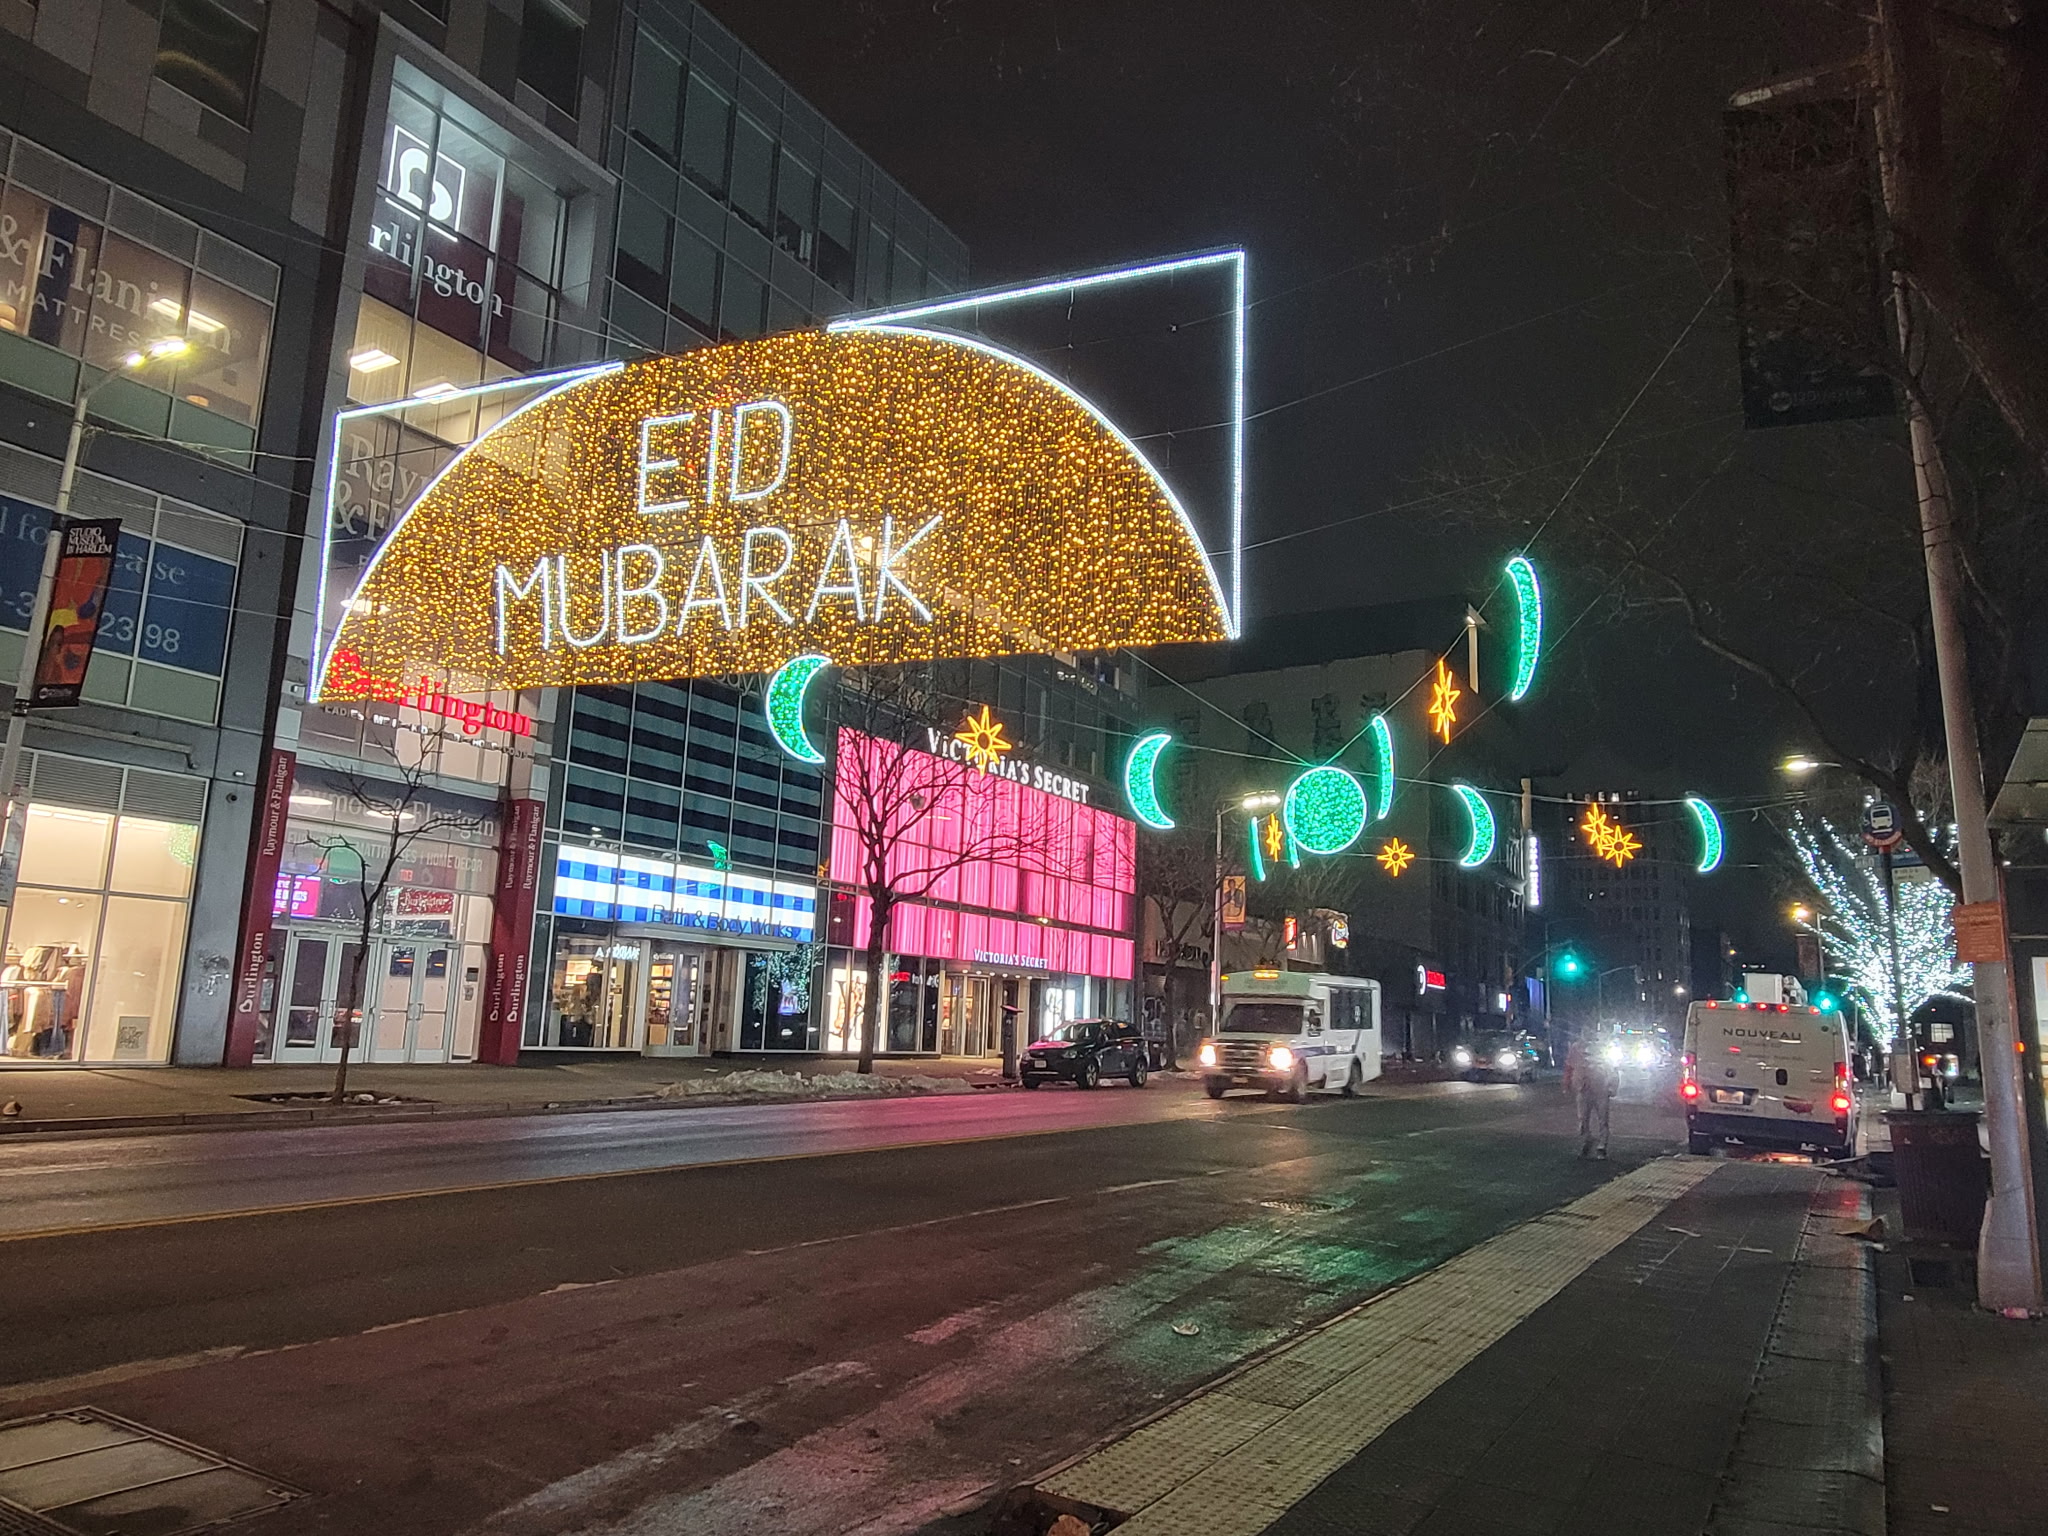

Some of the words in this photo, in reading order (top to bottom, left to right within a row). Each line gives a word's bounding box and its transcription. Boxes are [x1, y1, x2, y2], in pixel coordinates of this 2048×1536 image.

[637, 400, 792, 514] EID
[70, 527, 102, 537] STUDIO
[76, 544, 112, 554] HARLEM
[492, 514, 944, 656] MUBARAK
[927, 728, 1030, 785] VICTRIA'S
[1034, 766, 1090, 804] SECRET
[262, 809, 280, 857] Raymour
[271, 755, 289, 802] Flanigan
[529, 805, 541, 842] Flanigan
[454, 857, 483, 872] DECOR
[523, 851, 536, 890] Raymour
[652, 904, 689, 928] Bath
[692, 911, 705, 928] &
[708, 912, 748, 937] Body
[750, 916, 794, 938] Works
[239, 932, 265, 1013] Burlington
[973, 949, 1019, 968] VICTORIA'S
[1021, 956, 1048, 969] SECRET
[506, 954, 525, 1023] Burlington
[1723, 1027, 1801, 1041] NOUVEAU
